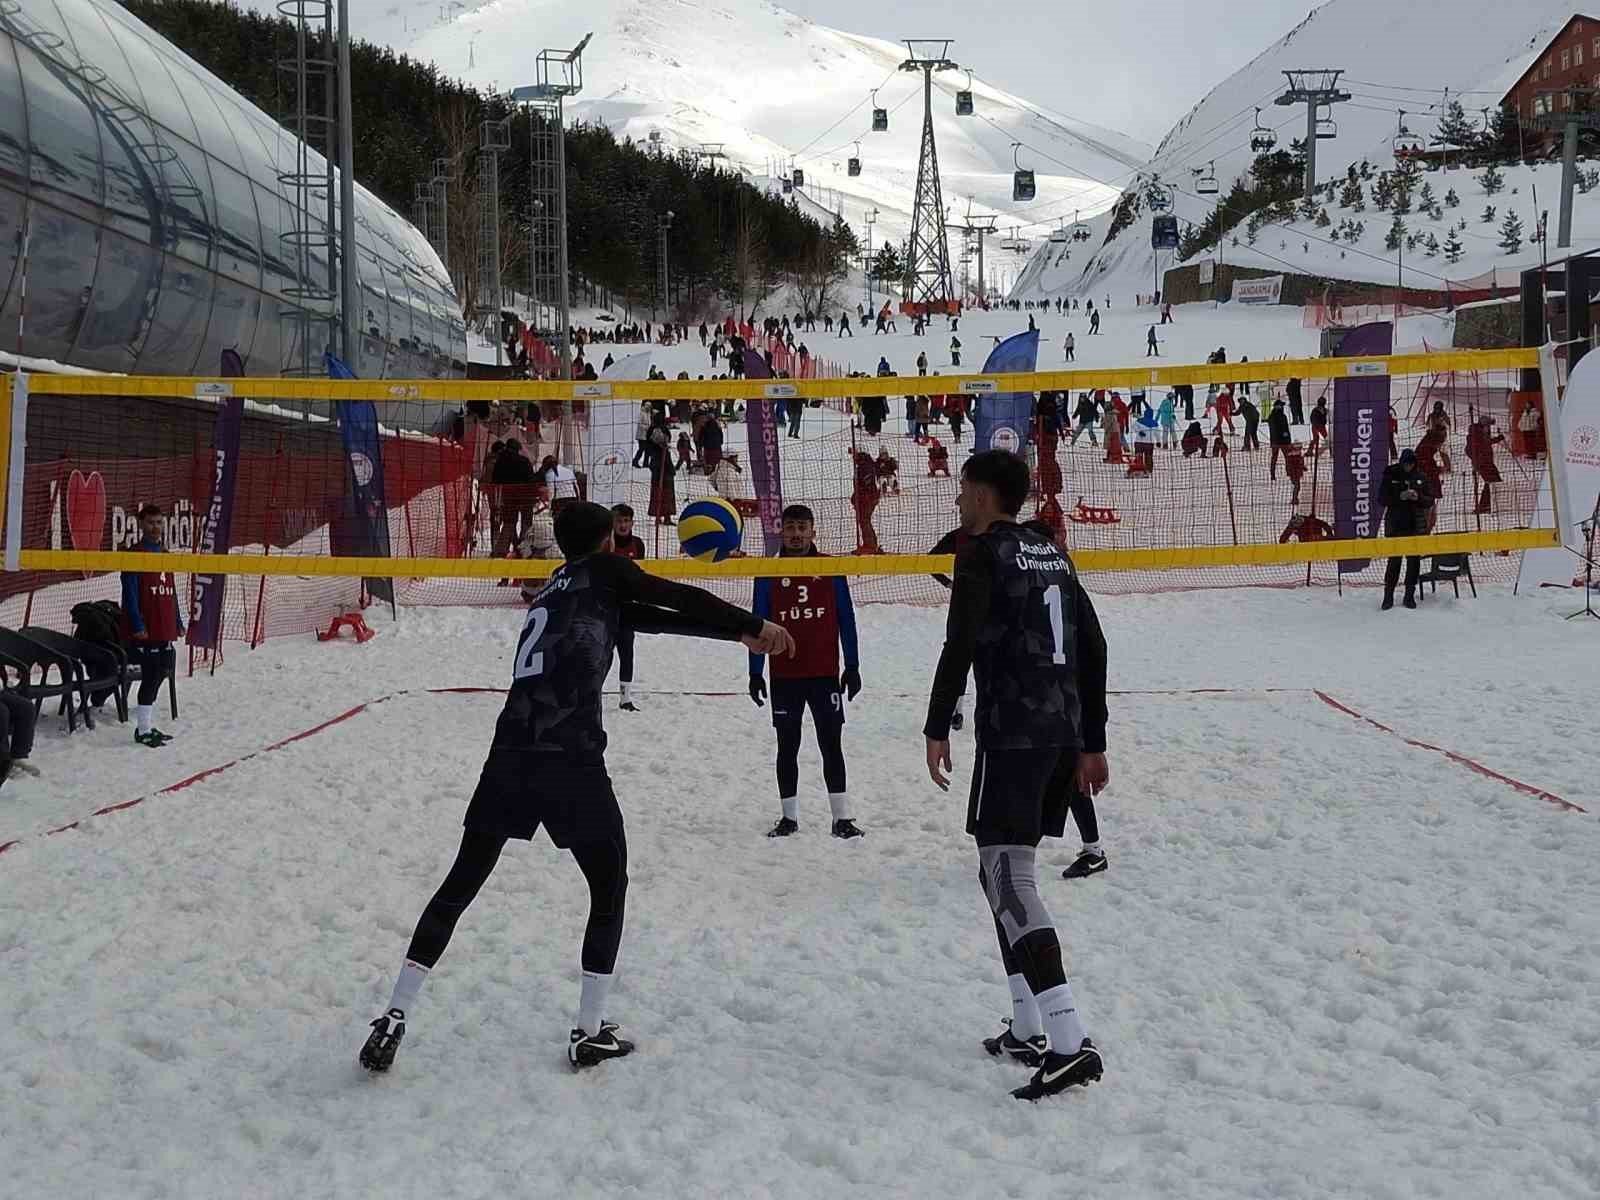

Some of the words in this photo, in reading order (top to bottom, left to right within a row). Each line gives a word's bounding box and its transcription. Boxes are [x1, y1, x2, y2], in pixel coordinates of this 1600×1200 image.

[1351, 407, 1373, 541] alandöken
[1018, 540, 1058, 556] Atatürk
[797, 585, 809, 603] 3
[779, 606, 825, 622] TÜSF
[1043, 584, 1066, 665] 1
[515, 606, 549, 679] 2
[830, 692, 841, 712] 9
